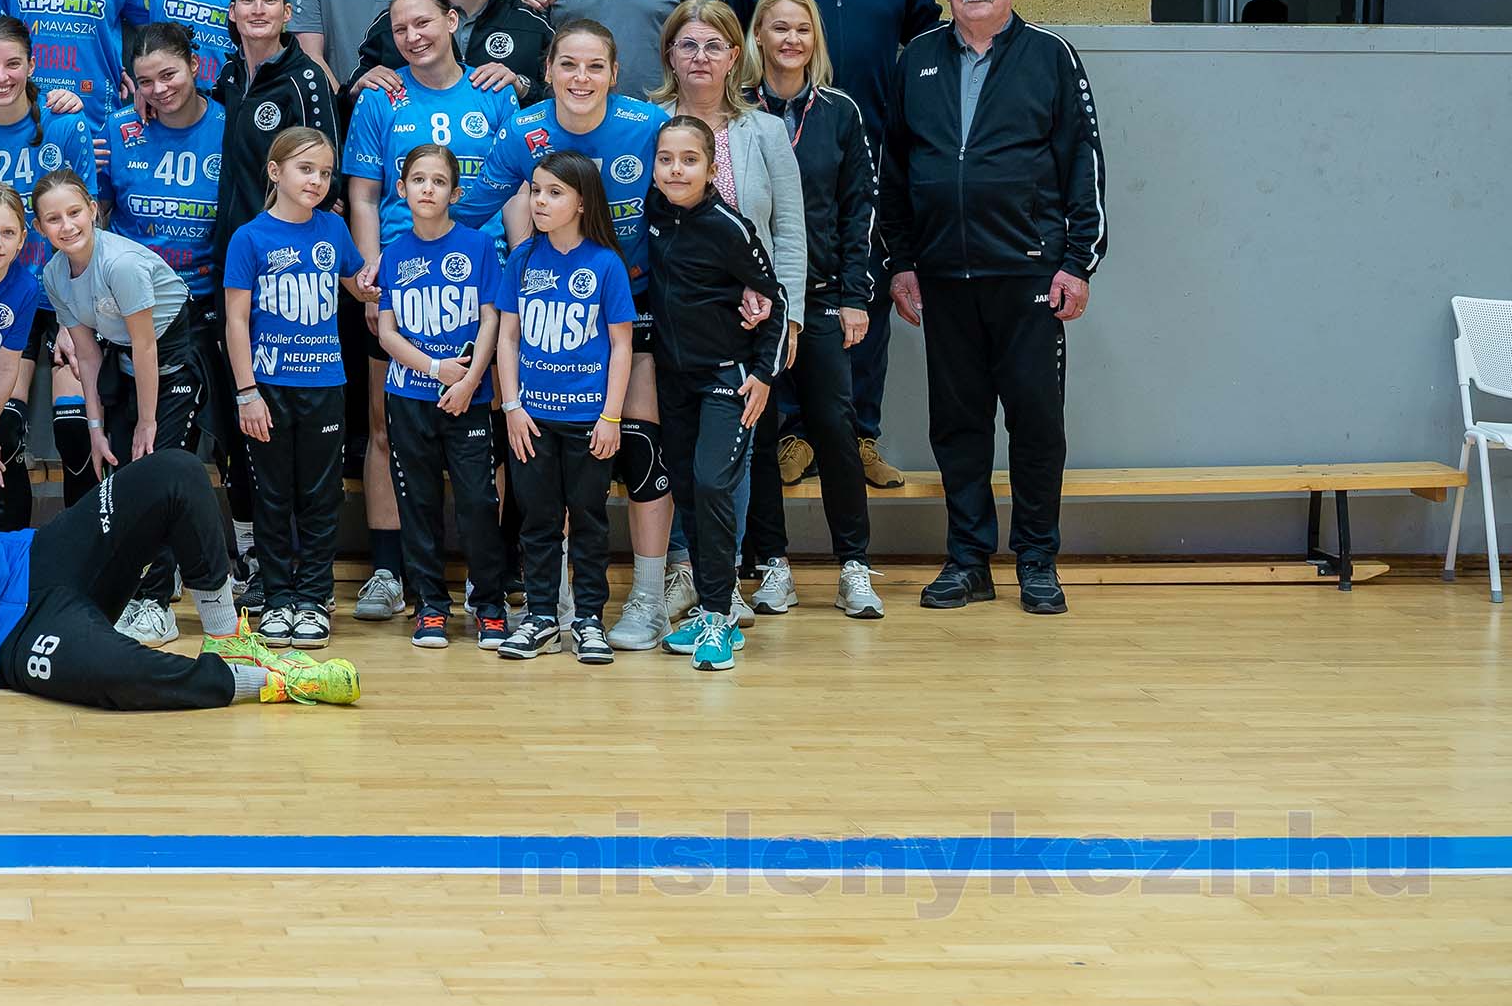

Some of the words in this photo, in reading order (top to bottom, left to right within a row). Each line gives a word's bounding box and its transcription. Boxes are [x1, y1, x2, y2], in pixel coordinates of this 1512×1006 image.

[167, 0, 228, 25] TiPPM
[39, 20, 97, 35] MAVASZK
[919, 66, 938, 77] JAKO
[393, 124, 416, 132] JAKO
[430, 112, 452, 146] 8
[127, 160, 149, 169] JAKO
[153, 151, 196, 186] 40
[1034, 293, 1050, 303] JAK
[266, 333, 292, 345] Koller
[294, 333, 329, 347] Csoport
[284, 352, 341, 364] NEUPERGER
[281, 365, 321, 373] PINCÉSZET
[535, 360, 576, 373] Csoport
[577, 361, 602, 374] tagja
[171, 385, 192, 393] JAKO
[409, 379, 441, 389] PINCÉSZ
[525, 390, 603, 403] NEUPERGER
[713, 386, 734, 396] JAKO
[527, 401, 568, 411] PINCÉSZET
[322, 424, 339, 433] JAKO
[468, 428, 486, 438] JAKO
[26, 634, 61, 680] 85
